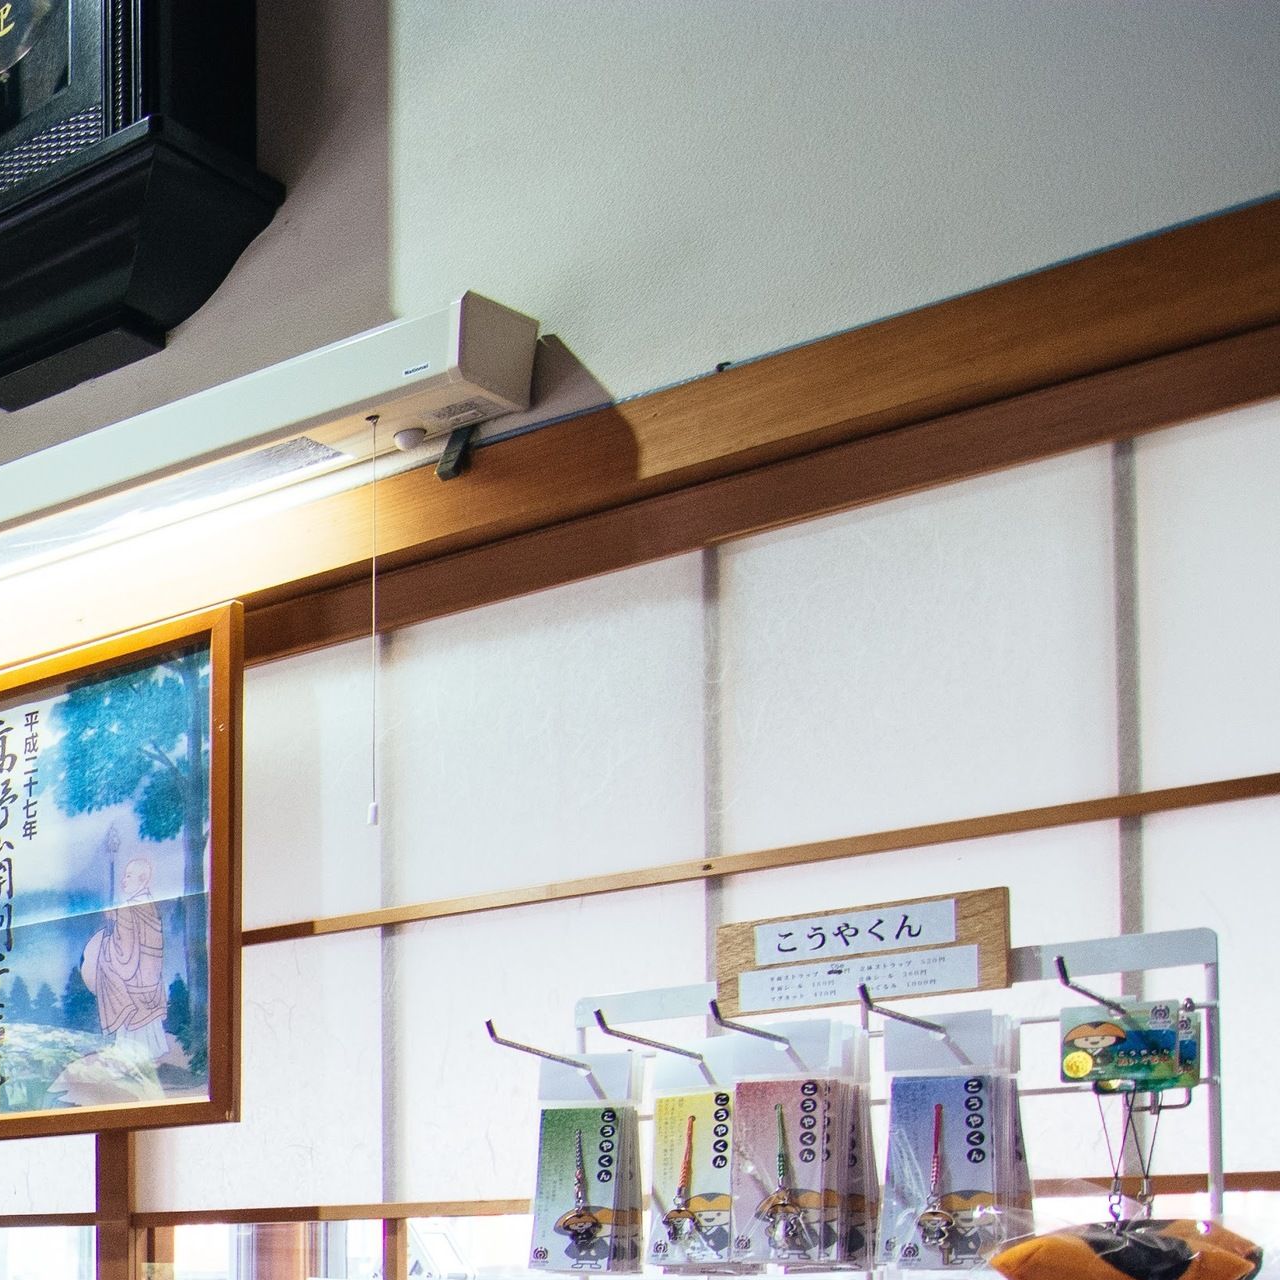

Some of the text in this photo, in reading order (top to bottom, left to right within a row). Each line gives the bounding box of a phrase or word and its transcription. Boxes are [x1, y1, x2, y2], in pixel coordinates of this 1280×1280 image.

[22, 711, 40, 841] 平成二十七年
[776, 913, 922, 953] こうやくん
[596, 1108, 617, 1184] こうやくん
[712, 1091, 731, 1170] こうやくん
[798, 1080, 819, 1164] こうやくん
[965, 1076, 987, 1164] こうやくん
